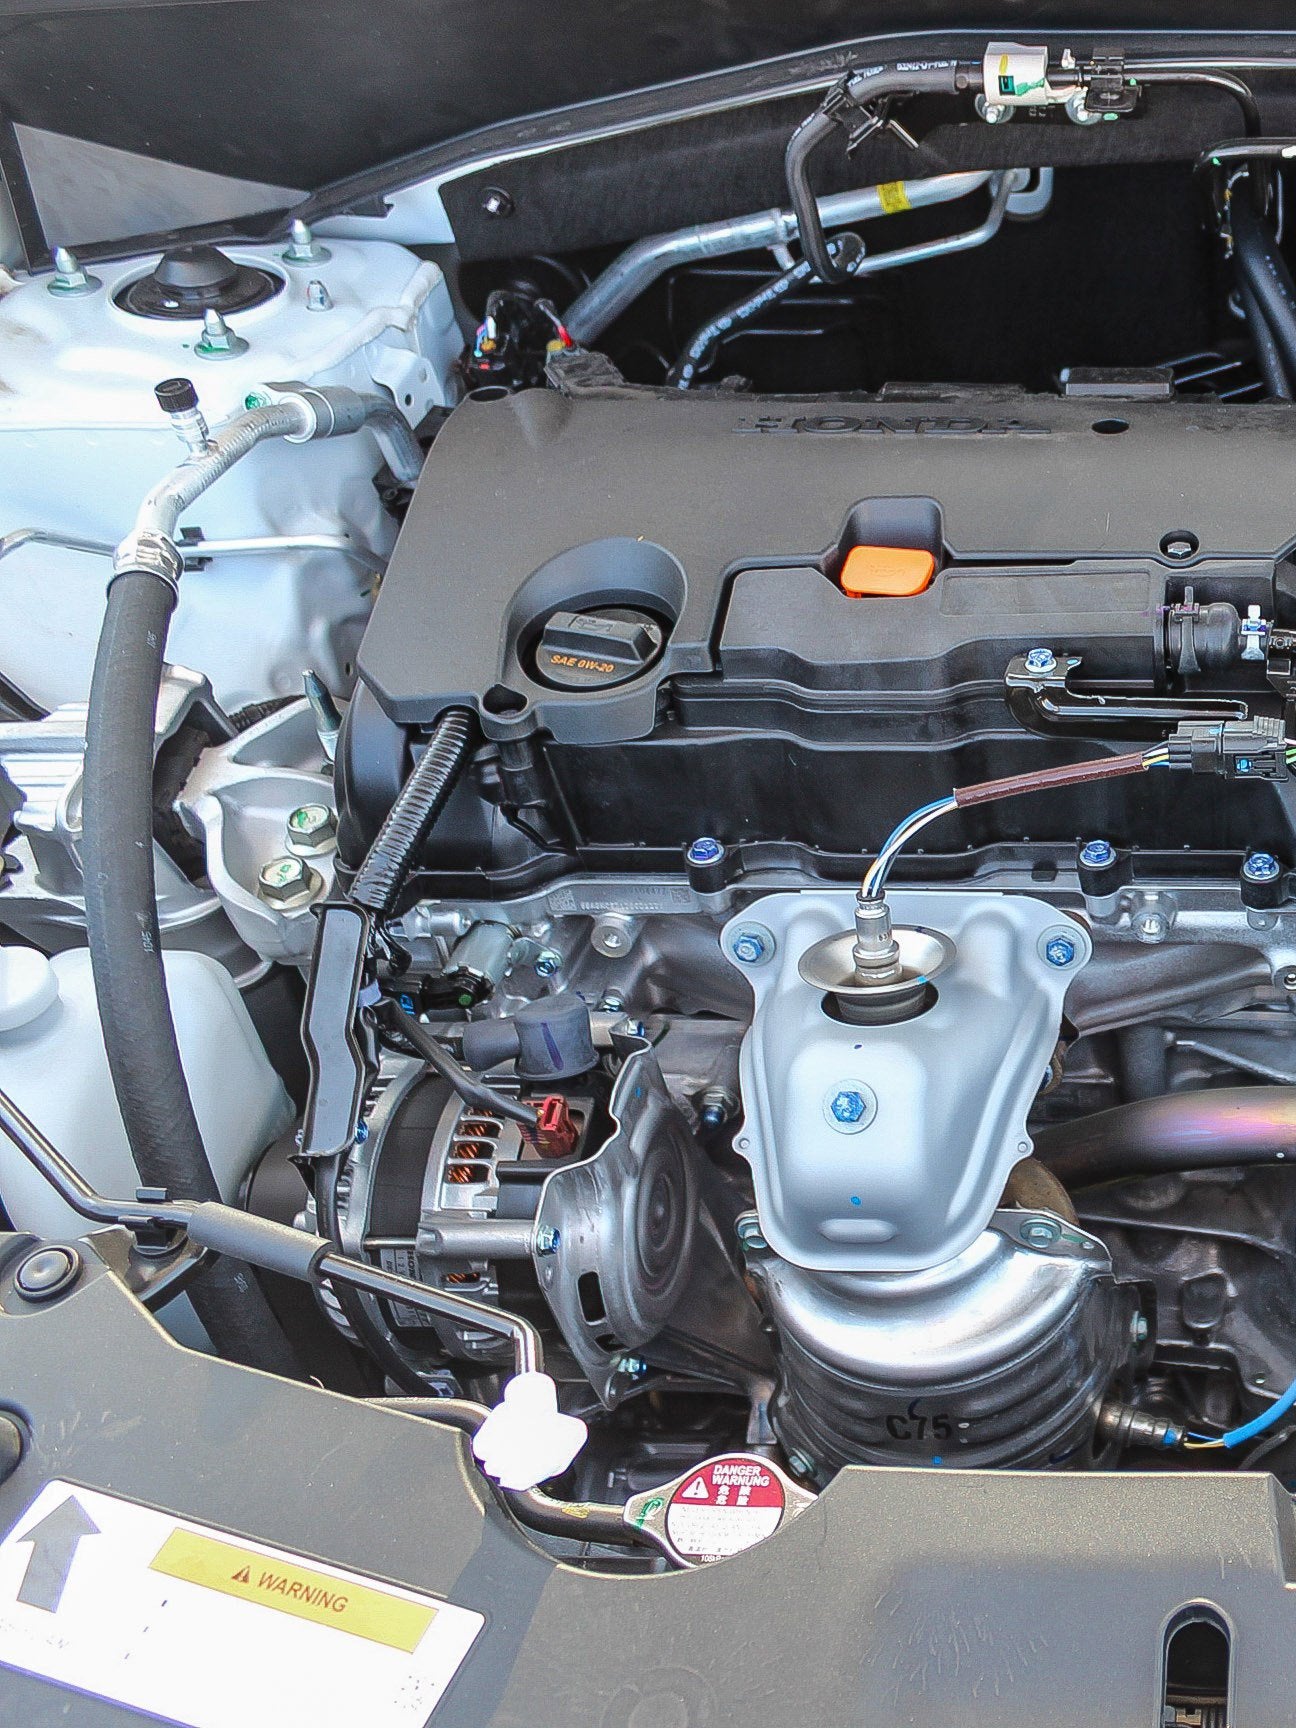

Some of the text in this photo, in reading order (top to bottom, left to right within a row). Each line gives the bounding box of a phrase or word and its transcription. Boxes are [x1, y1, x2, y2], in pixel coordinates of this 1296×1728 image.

[731, 415, 1052, 434] HONDA
[551, 654, 615, 673] SAE 0W-20
[713, 1464, 762, 1476] DANGER
[711, 1474, 771, 1487] WARNUNG
[257, 1571, 349, 1613] WARNING
